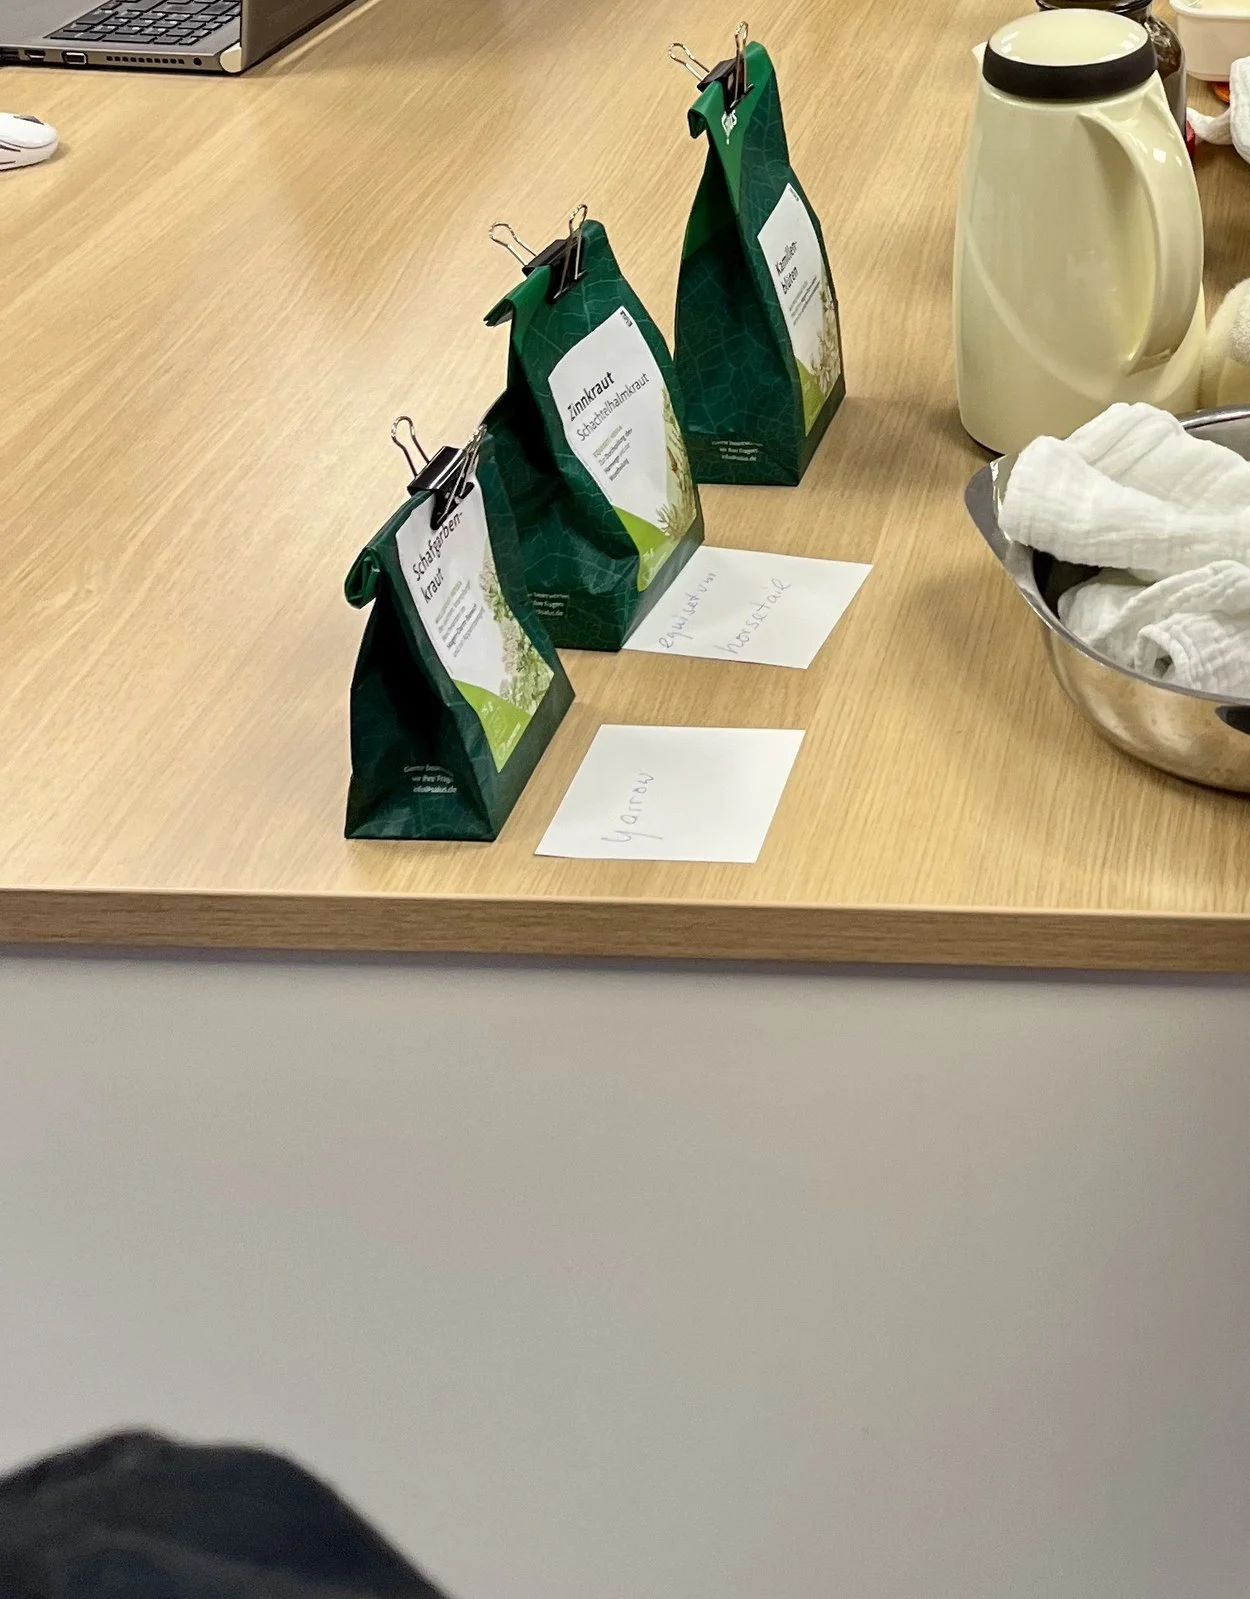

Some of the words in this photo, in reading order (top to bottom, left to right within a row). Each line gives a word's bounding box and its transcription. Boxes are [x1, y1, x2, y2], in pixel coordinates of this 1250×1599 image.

[780, 266, 800, 295] blüten
[567, 371, 615, 422] Zinnkraut
[576, 372, 650, 442] Schachtelhalmkraut
[411, 511, 464, 582] Schafgarben-
[420, 567, 445, 604] kraut
[714, 577, 793, 655] horsetail
